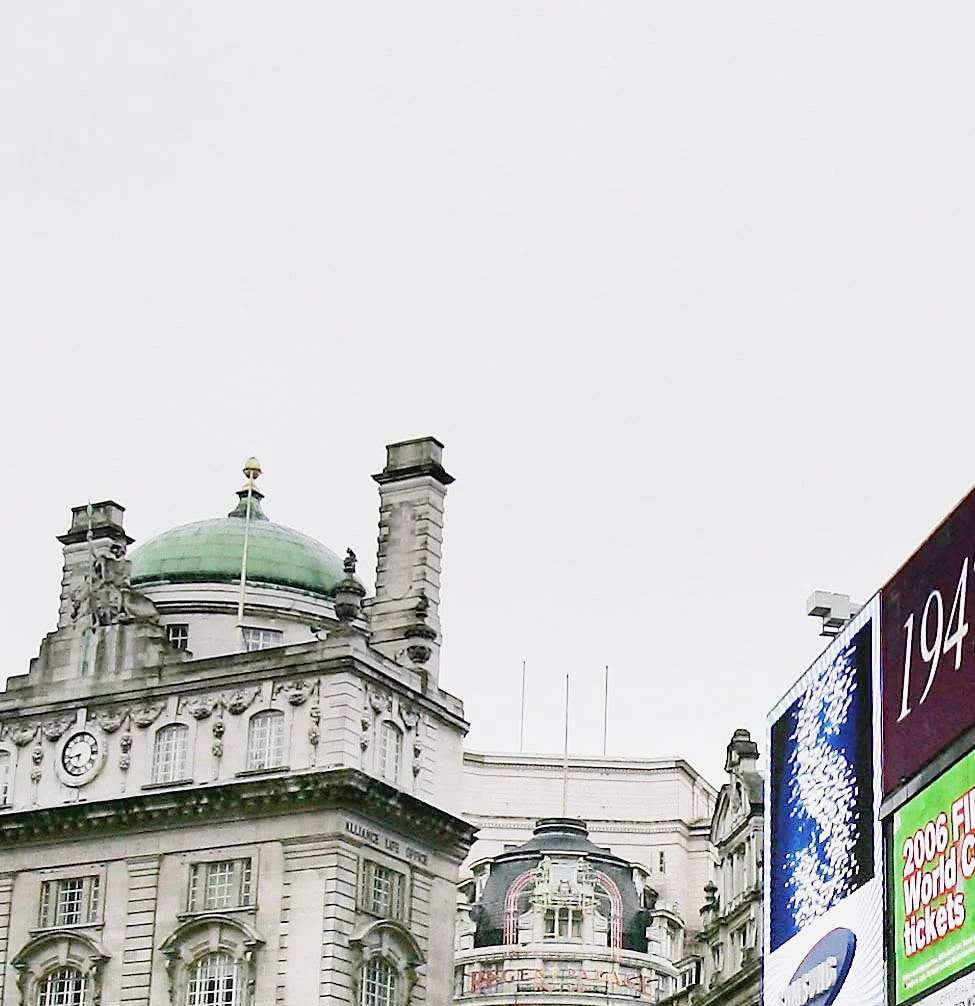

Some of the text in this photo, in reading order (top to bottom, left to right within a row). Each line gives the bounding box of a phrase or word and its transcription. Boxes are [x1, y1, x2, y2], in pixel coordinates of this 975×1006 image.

[896, 556, 975, 723] 194
[902, 811, 949, 876] 2006
[902, 845, 960, 916] World
[902, 891, 966, 958] tickets
